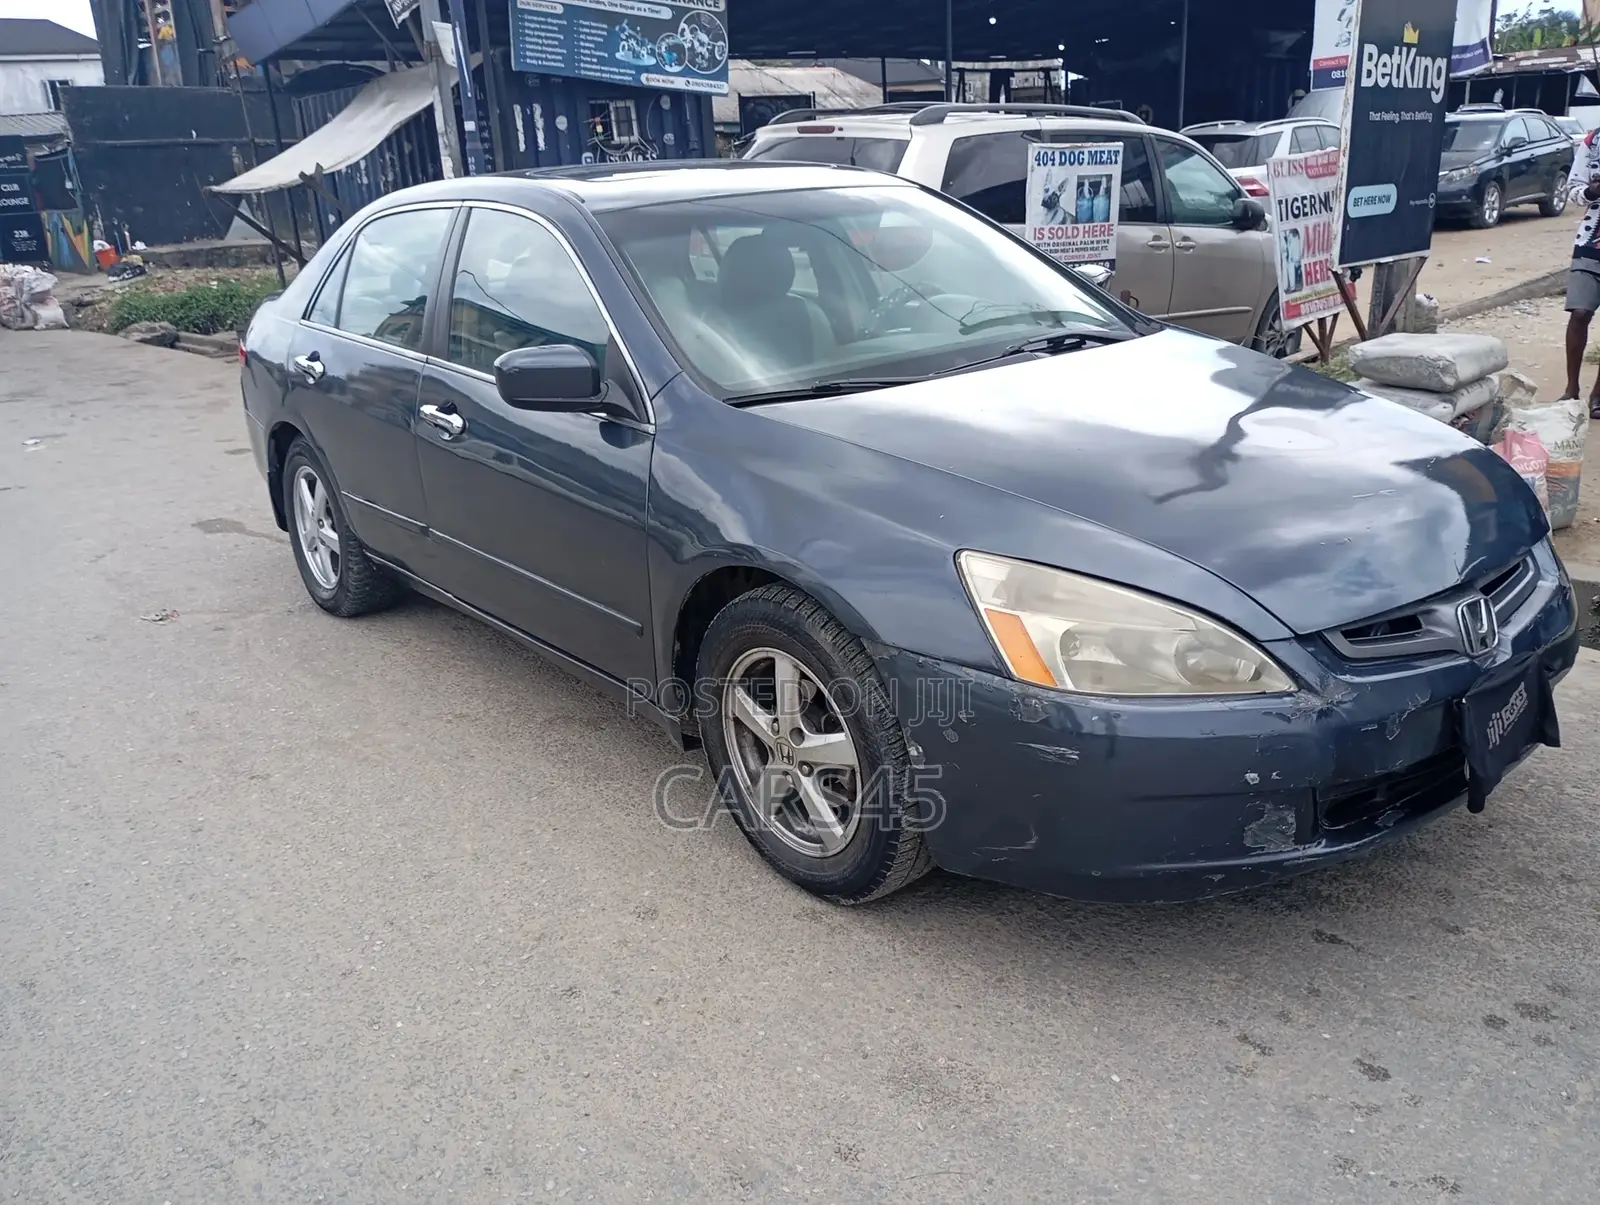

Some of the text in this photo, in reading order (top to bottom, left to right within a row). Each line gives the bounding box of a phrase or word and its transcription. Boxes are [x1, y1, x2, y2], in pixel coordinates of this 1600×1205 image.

[1360, 44, 1448, 104] BetKing
[1034, 150, 1120, 166] 404 DOG MEAT
[1273, 159, 1303, 178] BLISS
[1353, 194, 1391, 207] BET HERE NOW
[1033, 224, 1114, 240] IS SOLD HERE
[1304, 258, 1331, 286] HERE
